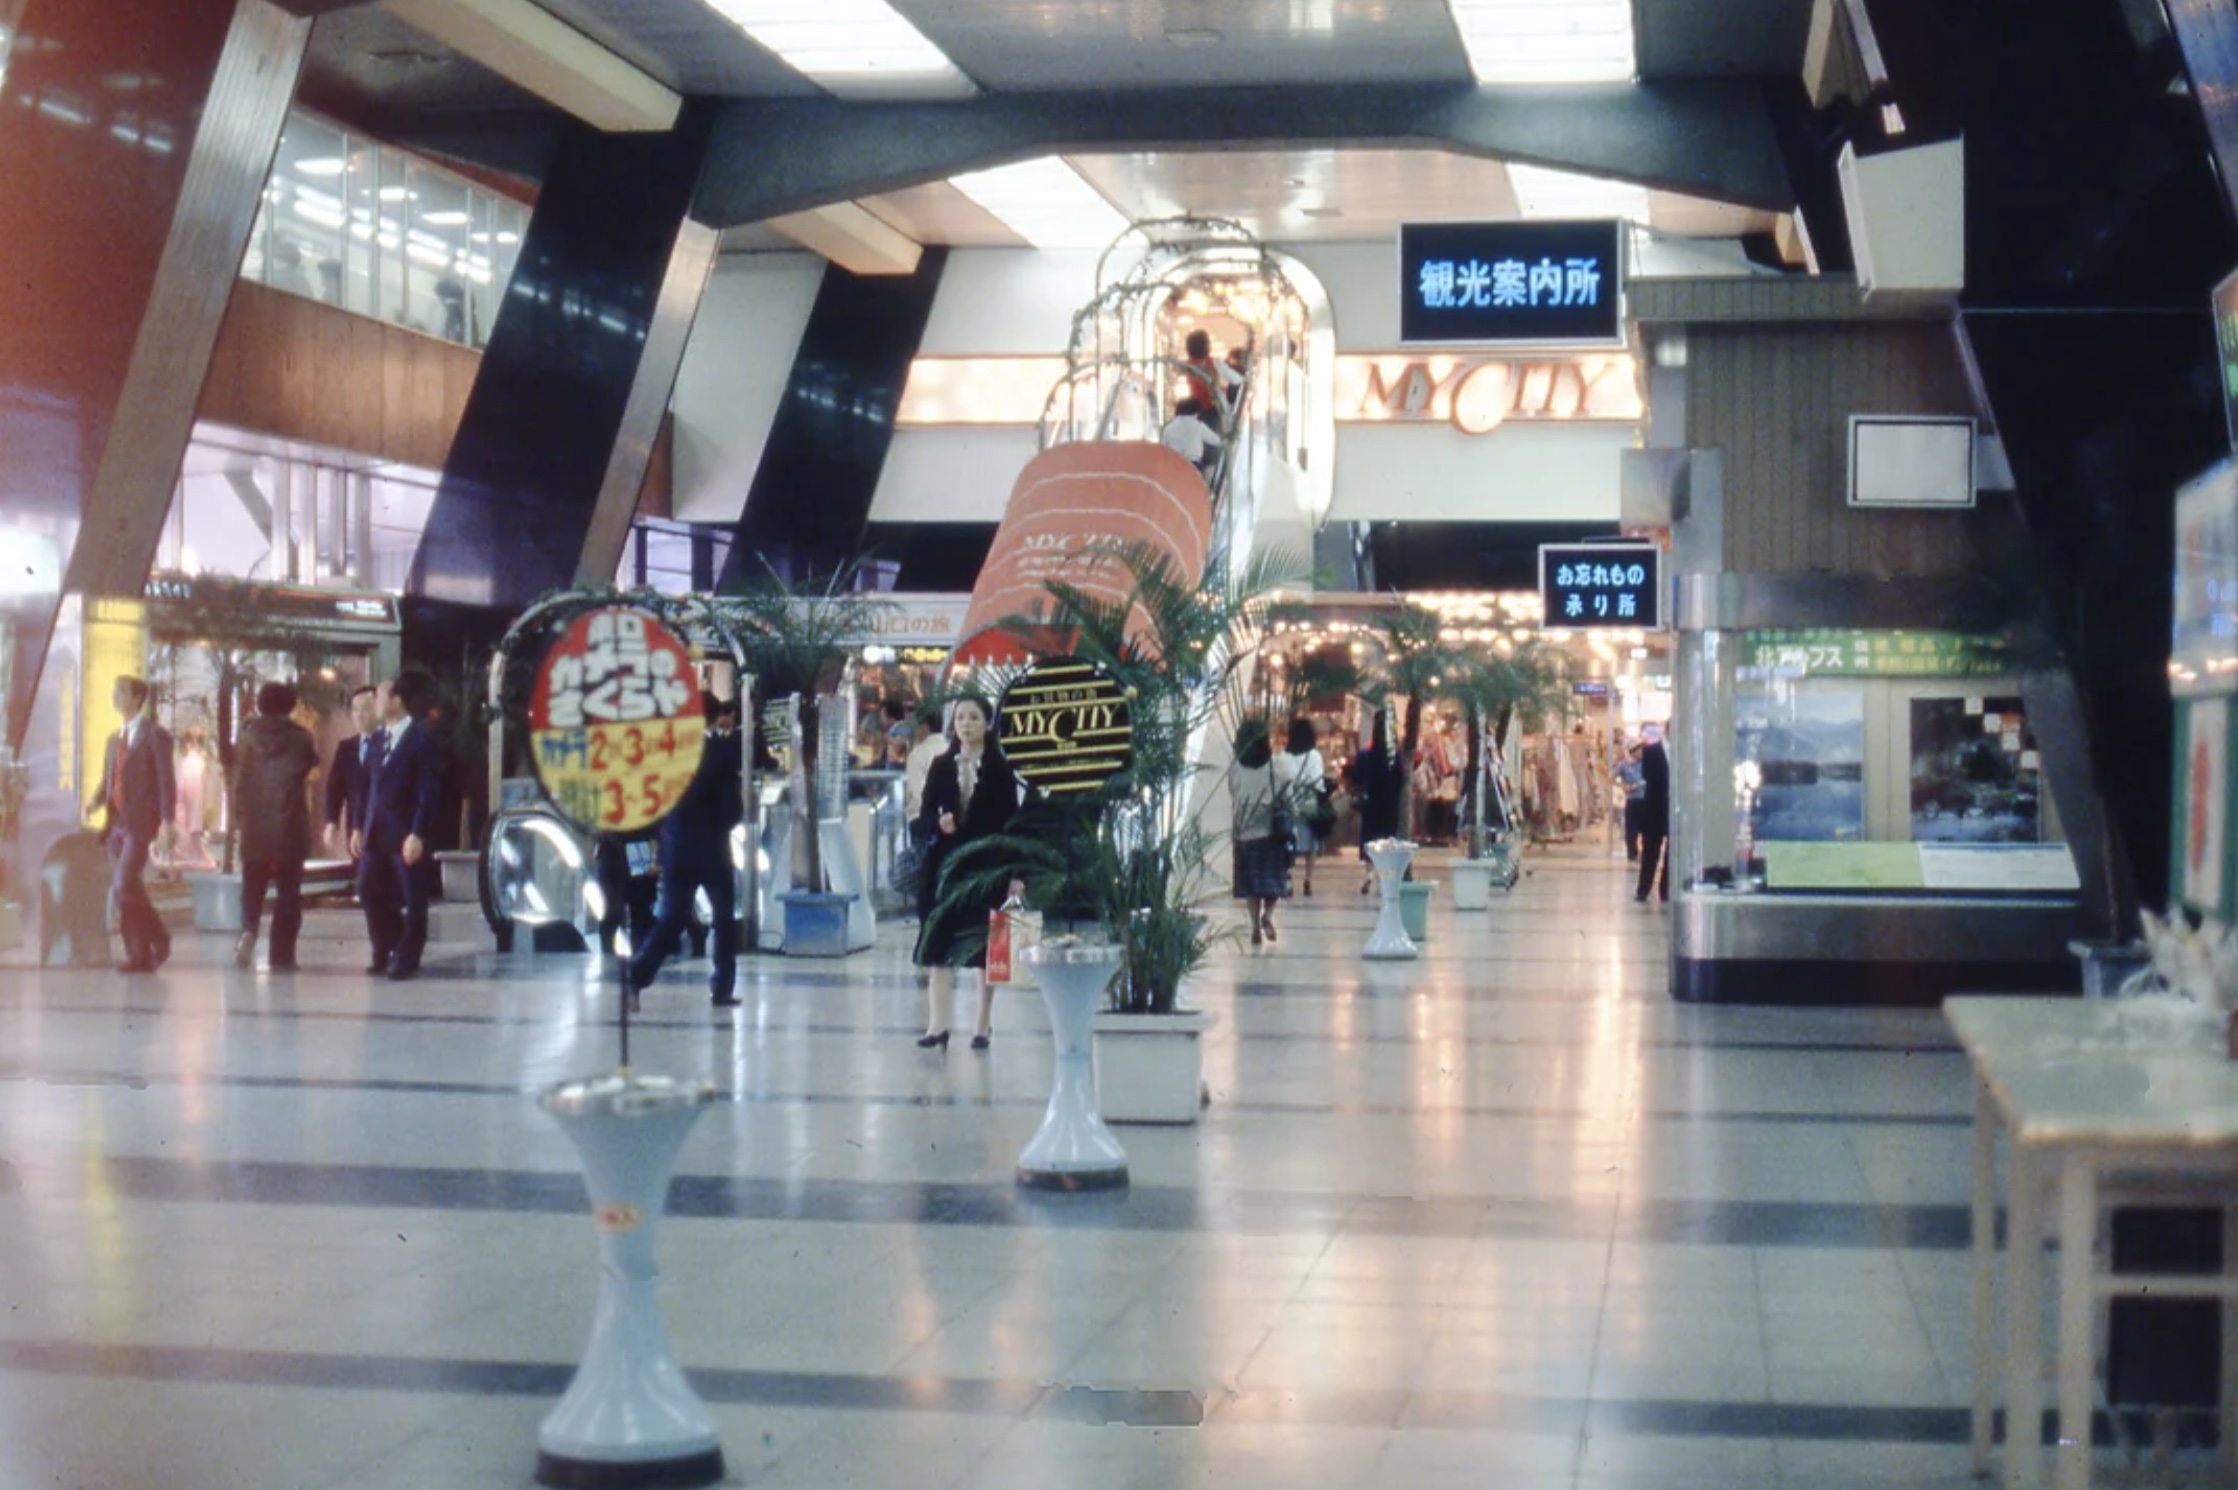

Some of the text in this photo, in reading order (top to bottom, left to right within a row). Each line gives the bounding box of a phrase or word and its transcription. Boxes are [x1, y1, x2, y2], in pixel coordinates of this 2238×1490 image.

[1419, 258, 1601, 307] 観光案内所
[1557, 563, 1645, 586] お忘れもの
[1565, 593, 1637, 617] 承り所
[547, 677, 690, 728] さくらや
